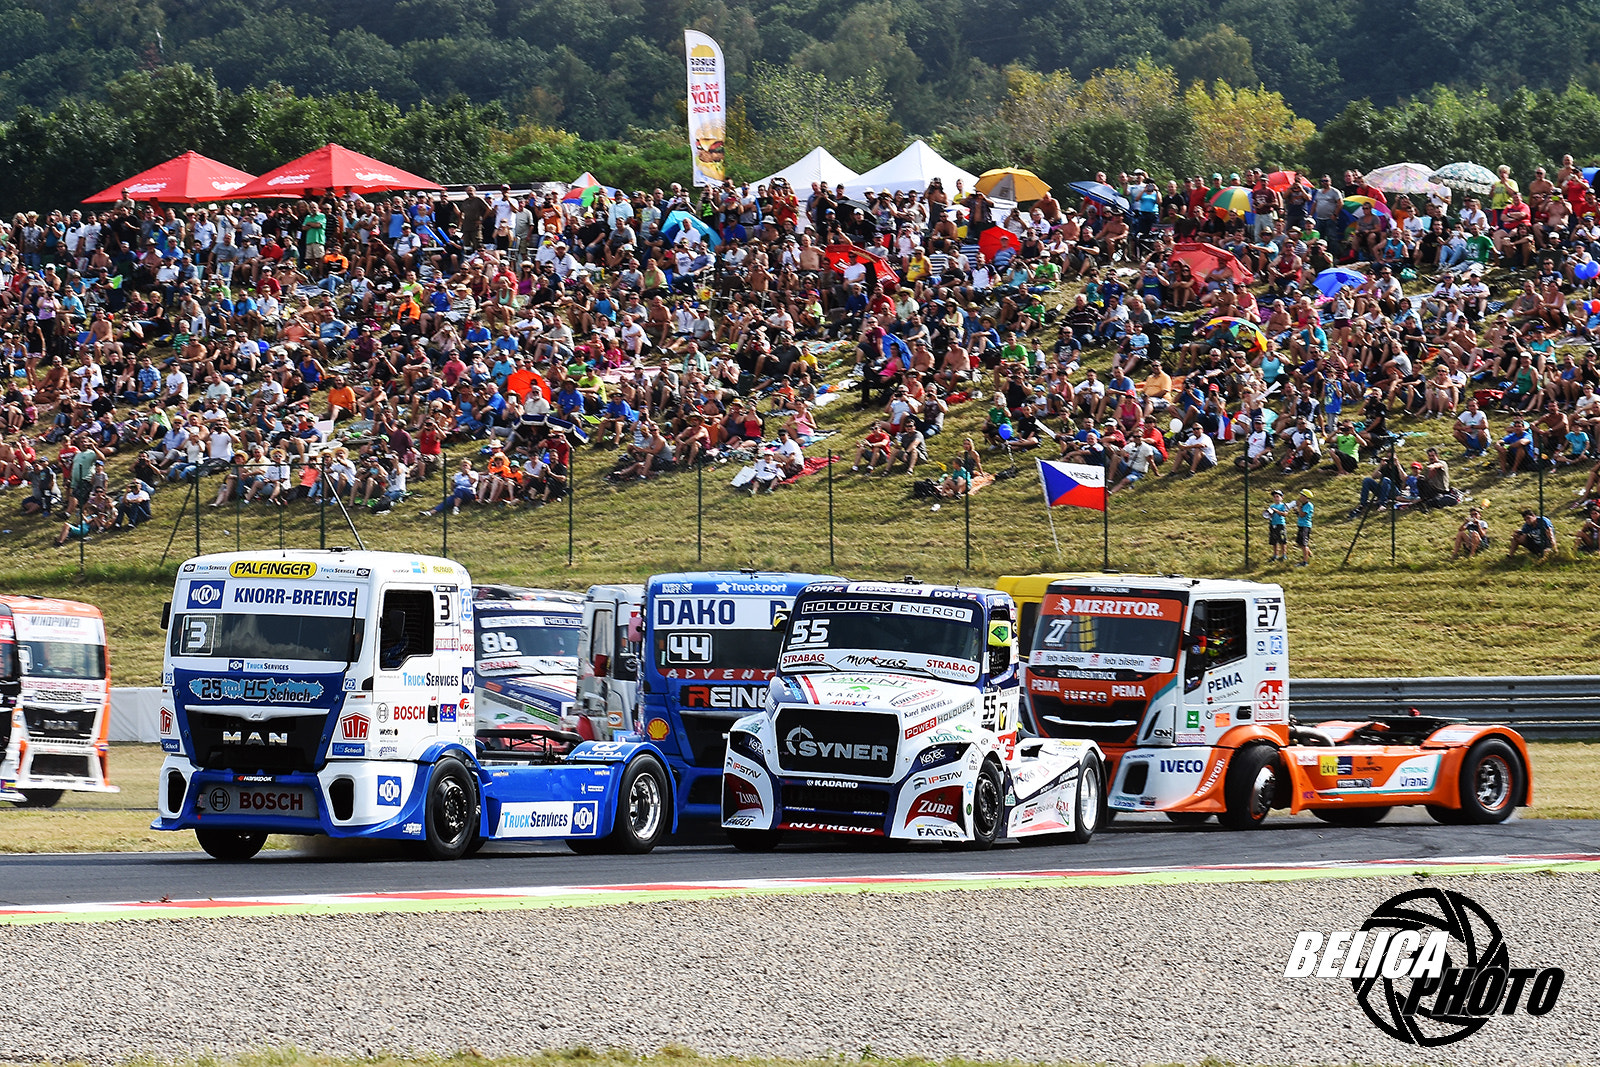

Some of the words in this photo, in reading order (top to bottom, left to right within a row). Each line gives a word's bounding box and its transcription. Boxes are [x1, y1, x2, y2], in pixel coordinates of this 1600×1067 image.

[234, 562, 311, 576] PALFINGER
[731, 582, 787, 593] Truckport
[234, 587, 357, 607] KNORR-BREMSE
[440, 595, 450, 620] 3
[658, 600, 736, 625] DAKO
[804, 602, 891, 612] HOLOUBEK
[900, 604, 966, 619] ENERGO
[1073, 599, 1160, 617] MERITOR
[1257, 605, 1279, 627] 27
[187, 621, 208, 648] 3
[790, 618, 831, 644] 55
[480, 632, 519, 653] 86
[670, 636, 710, 660] 44
[783, 653, 825, 664] STRABAG
[926, 659, 976, 674] STRABAG
[201, 680, 222, 698] 25
[243, 680, 268, 700] HS
[269, 687, 311, 702] Schoch
[1031, 679, 1060, 693] PEMA
[1112, 685, 1146, 697] PEMA
[1207, 672, 1243, 694] PEMA
[1064, 690, 1108, 703] IVECO
[394, 706, 426, 720] BOSCH
[904, 708, 919, 719] Karel
[982, 695, 997, 719] 55
[906, 718, 937, 738] POWER
[938, 701, 975, 723] HOLOUBEK
[223, 731, 289, 746] MAN
[799, 740, 889, 761] SYNER
[1160, 759, 1204, 773] IVECO
[814, 779, 859, 789] KADAMO
[1194, 757, 1226, 797] MERITOR
[239, 792, 304, 810] BOSCH
[917, 800, 954, 815] ZUBR
[788, 822, 875, 833] NUTREND
[916, 828, 960, 839] FAGUS
